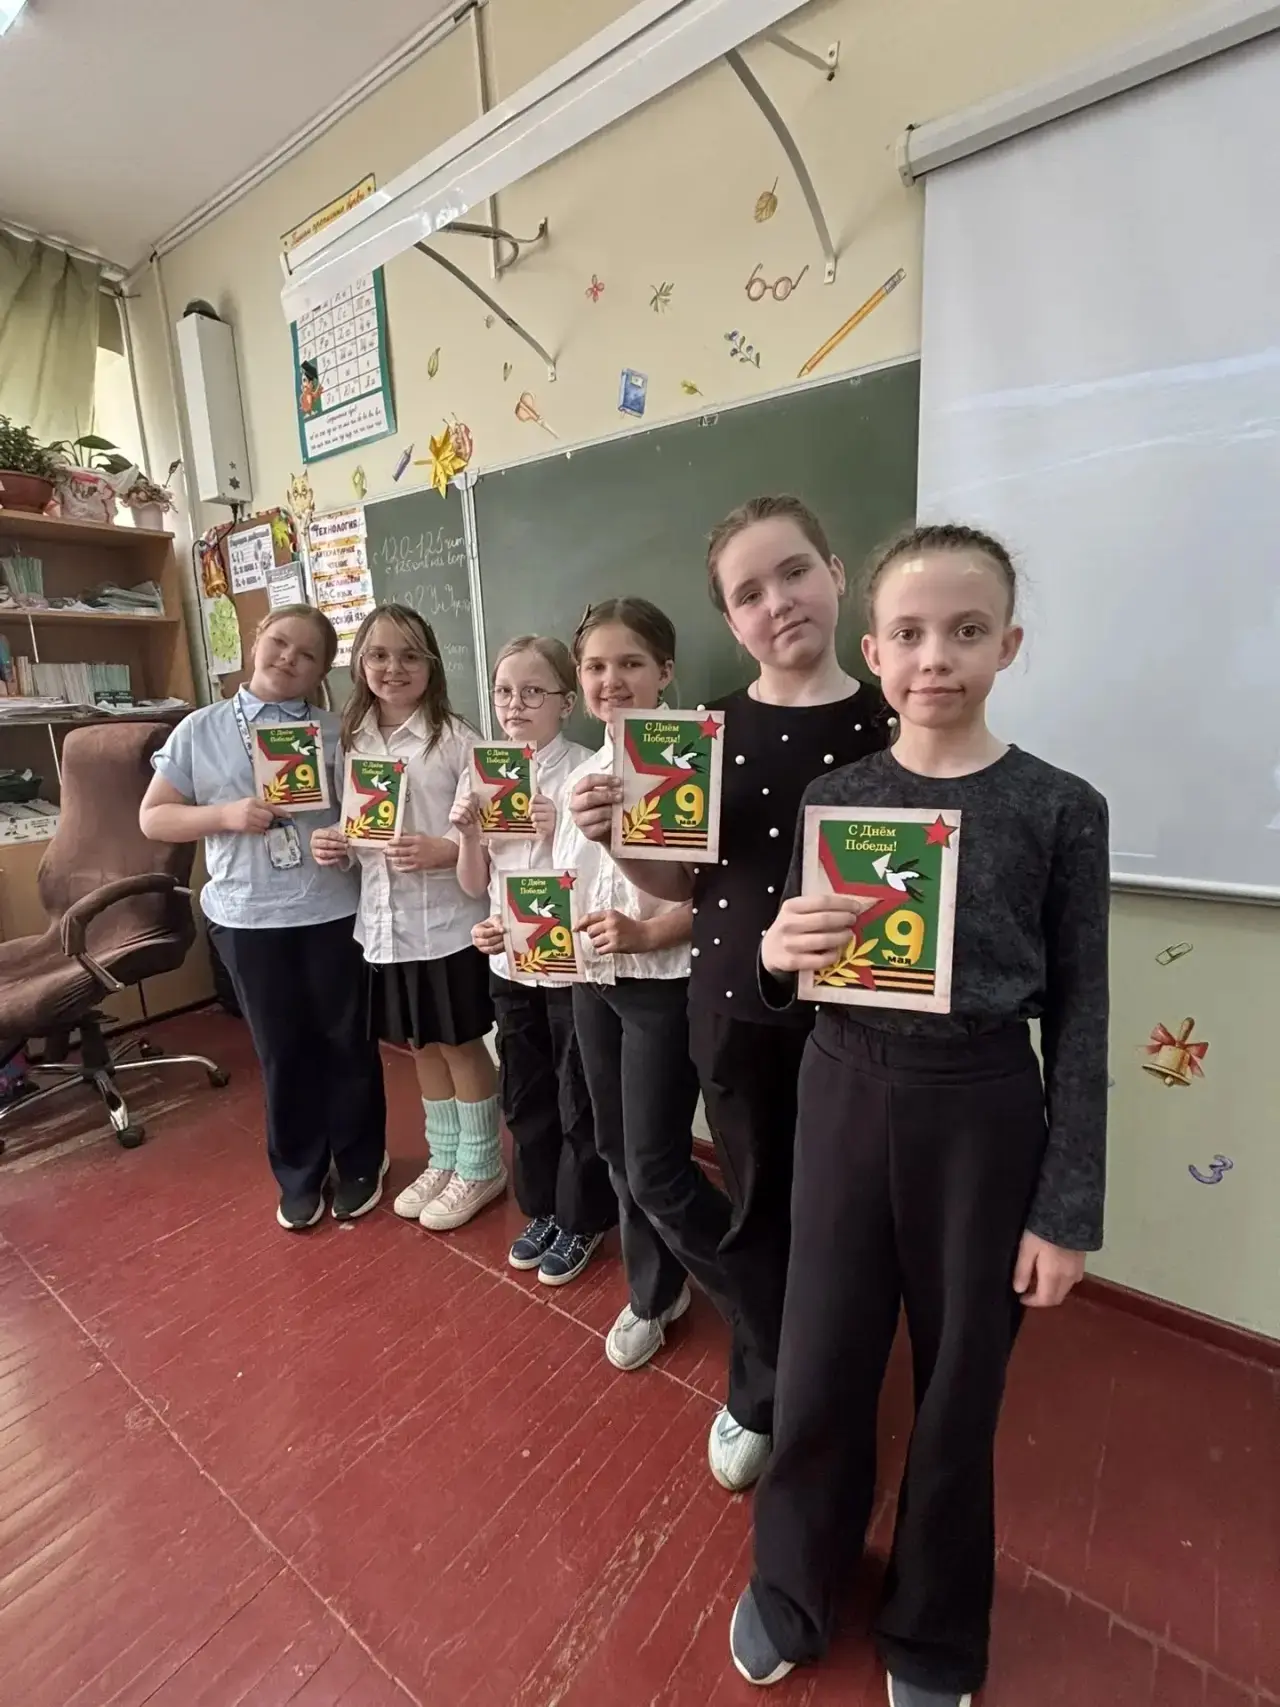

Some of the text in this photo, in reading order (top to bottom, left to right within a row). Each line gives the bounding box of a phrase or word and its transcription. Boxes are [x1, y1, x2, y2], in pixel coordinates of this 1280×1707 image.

[643, 734, 680, 744] Победы!
[645, 722, 679, 732] С Днём
[295, 764, 315, 790] 9
[377, 800, 395, 828] 9
[511, 792, 529, 820] 9
[674, 784, 704, 828] 9
[848, 824, 896, 838] С Днём
[844, 840, 897, 852] Победы!
[550, 926, 572, 958] 9
[882, 910, 925, 966] 9
[887, 956, 912, 965] мая
